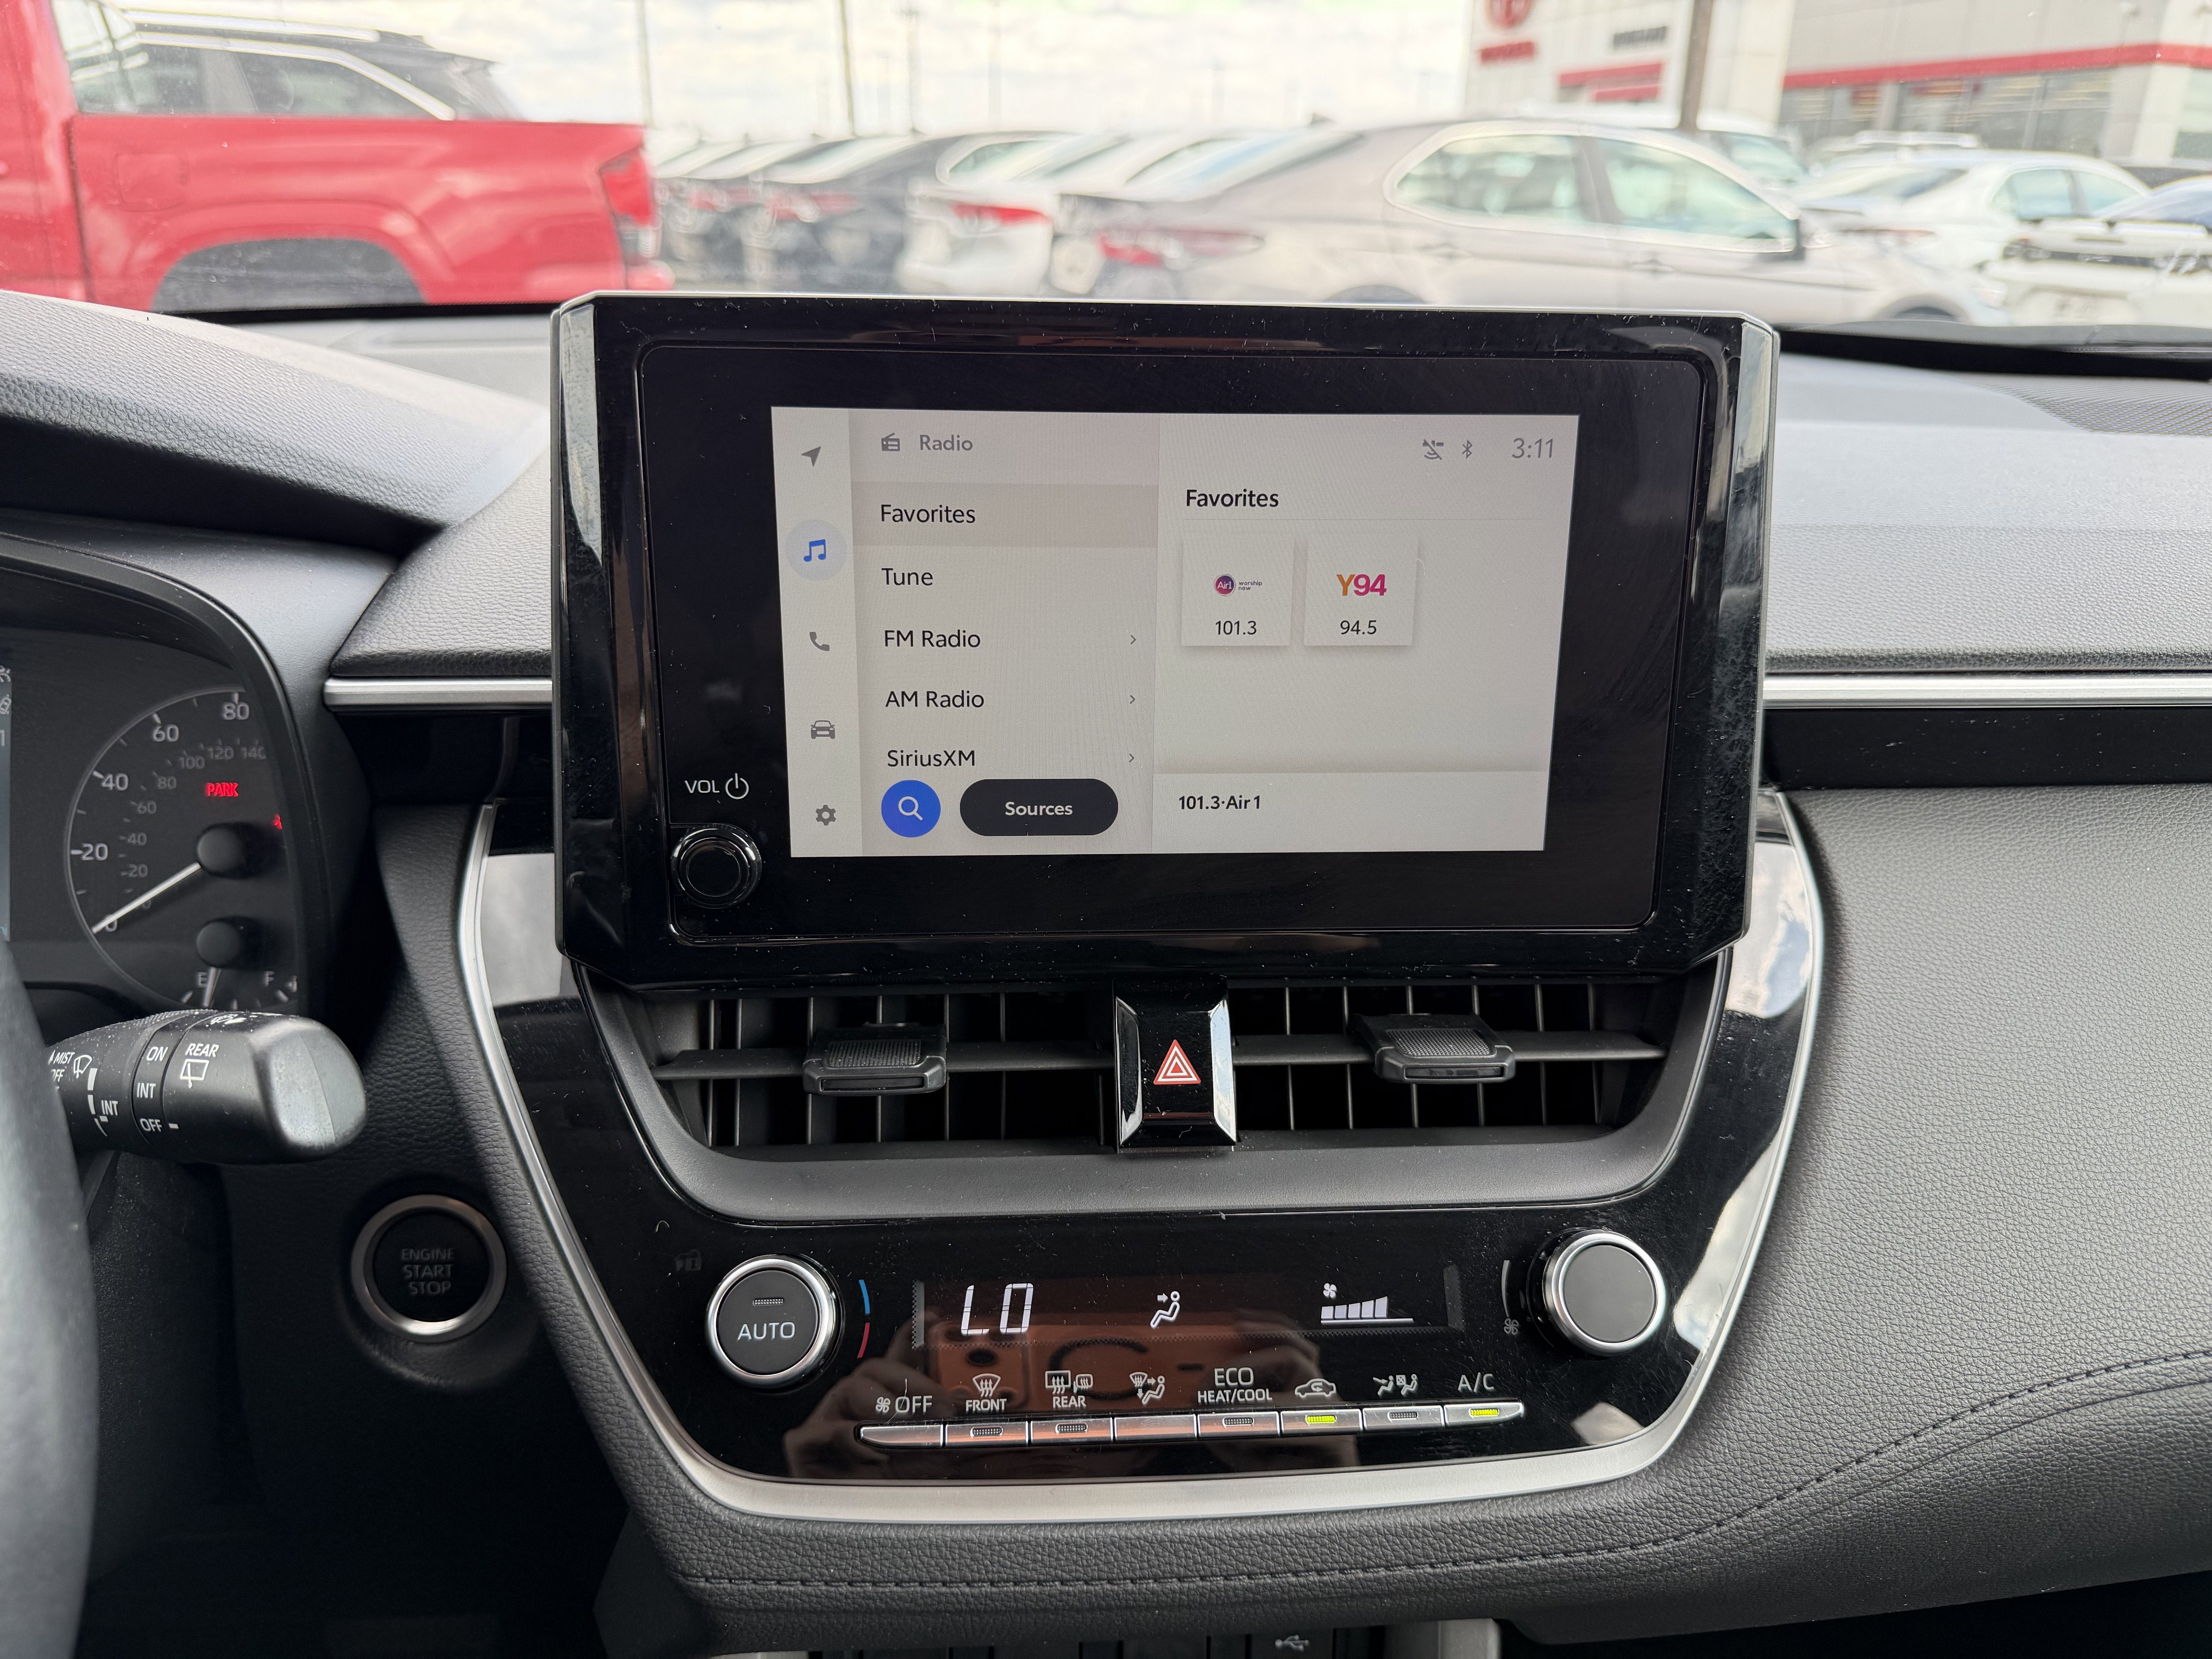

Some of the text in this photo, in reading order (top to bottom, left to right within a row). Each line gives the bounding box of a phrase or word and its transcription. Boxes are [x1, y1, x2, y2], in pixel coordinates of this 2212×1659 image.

[919, 434, 974, 452] Radio
[1511, 438, 1555, 459] 3:11
[1185, 489, 1279, 508] Favorites
[880, 504, 976, 524] Favorites
[881, 568, 934, 586] Tune
[1336, 574, 1387, 596] Y94
[1215, 620, 1257, 635] 101.3
[1340, 620, 1377, 635] 94.5
[884, 630, 981, 648] FM Radio
[885, 690, 984, 708] AM Radio
[222, 703, 250, 721] 80
[153, 725, 179, 742] 60
[208, 747, 234, 760] 120
[887, 750, 975, 768] SiriusXM
[179, 756, 205, 769] 100
[101, 774, 129, 791] 40
[157, 776, 177, 790] 80
[206, 782, 239, 797] PARK
[685, 780, 720, 793] VOL
[137, 800, 157, 814] 60
[1005, 801, 1073, 816] Sources
[127, 833, 147, 845] 40
[82, 843, 108, 861] 20
[128, 864, 148, 878] 20
[197, 972, 207, 987] E
[264, 972, 275, 986] F
[146, 1046, 168, 1061] ON
[185, 1043, 219, 1057] REAR
[53, 1052, 75, 1064] MIST
[137, 1083, 156, 1098] INT
[101, 1099, 118, 1116] INT
[140, 1119, 163, 1132] OFF
[401, 1248, 453, 1260] ENGINE
[403, 1264, 453, 1279] START
[408, 1281, 451, 1295] STOP
[737, 1322, 795, 1341] AUTO
[1214, 1368, 1254, 1387] ECO
[1458, 1374, 1494, 1393] A/C
[1052, 1396, 1086, 1408] REAR
[1197, 1388, 1273, 1404] HEAT/COOL
[895, 1395, 933, 1414] OFF
[965, 1398, 1007, 1412] FRONT
